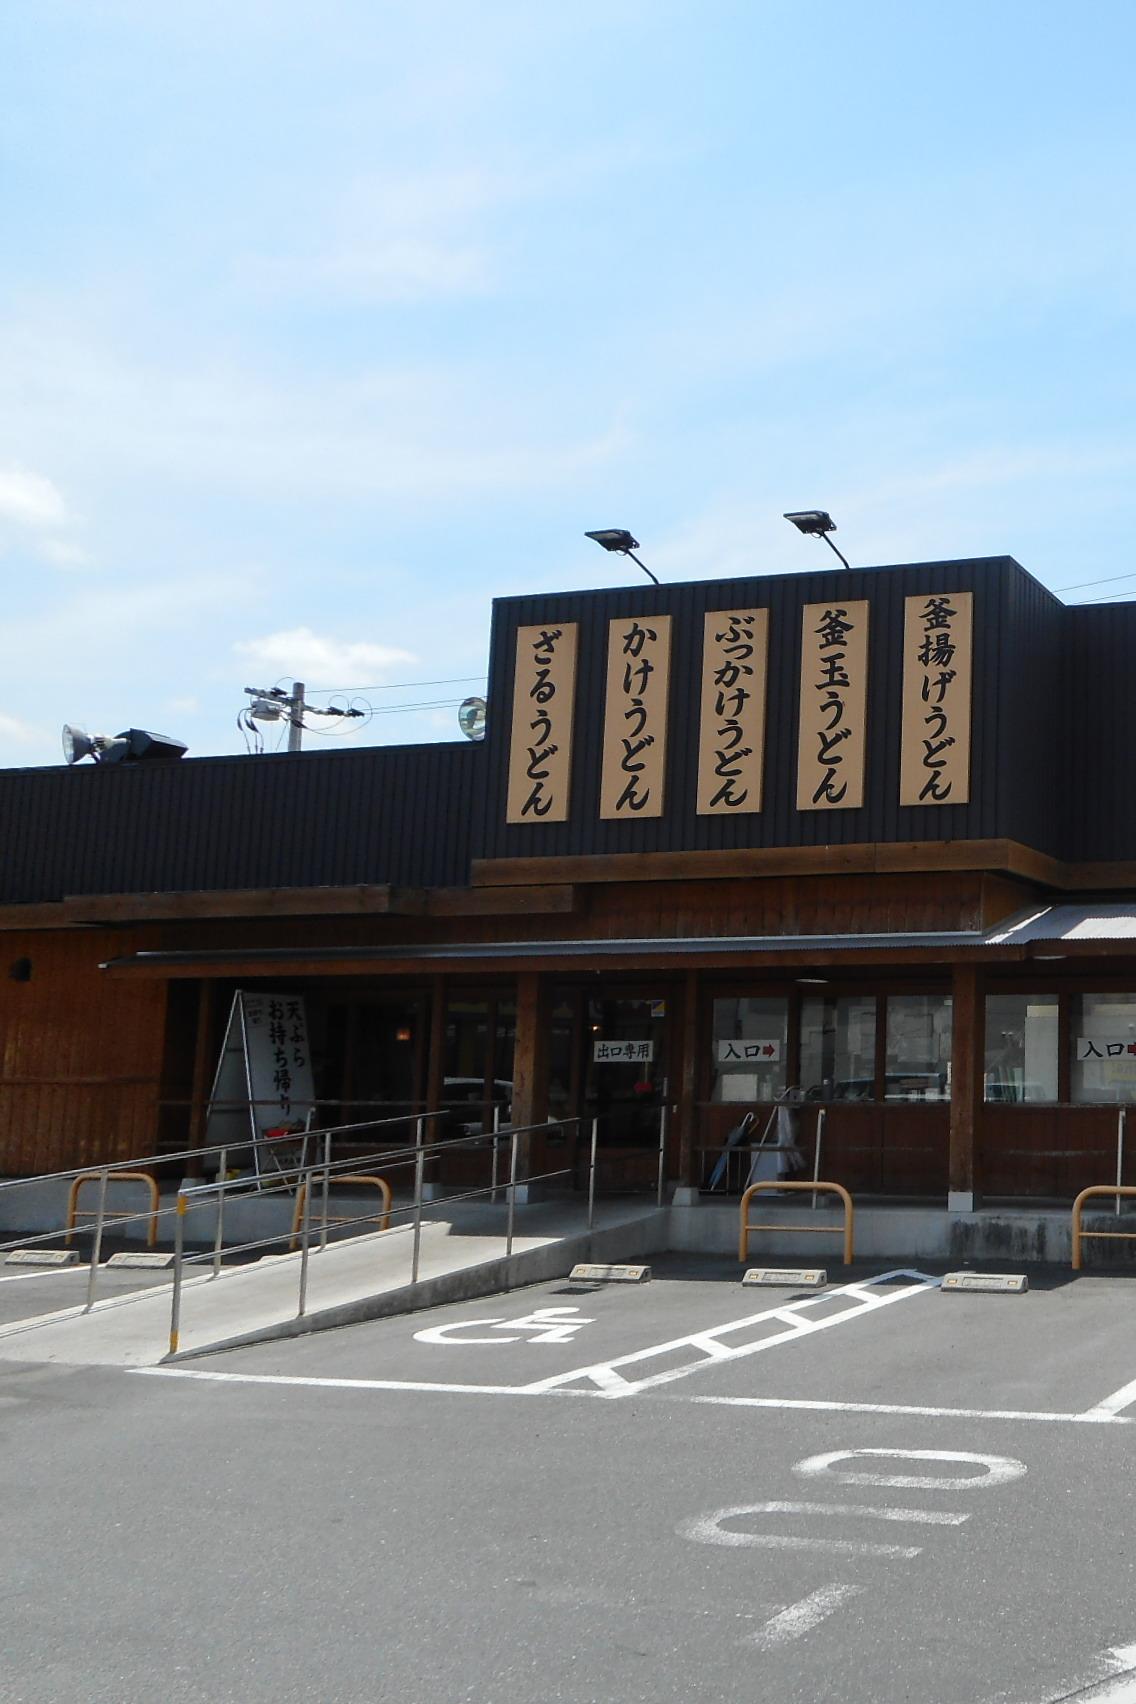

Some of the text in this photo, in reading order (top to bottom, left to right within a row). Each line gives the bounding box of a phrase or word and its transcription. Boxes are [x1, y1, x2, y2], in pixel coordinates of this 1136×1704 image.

[520, 629, 562, 817] ざるうどん
[615, 621, 656, 812] かけうどん
[709, 615, 755, 808] ぶっかけうどん
[813, 608, 854, 805] 釜玉うどん
[918, 597, 959, 802] 釜揚げうどん
[597, 1042, 650, 1060] 出口専用
[724, 1042, 760, 1059] 入口
[1082, 1040, 1126, 1057] 入口
